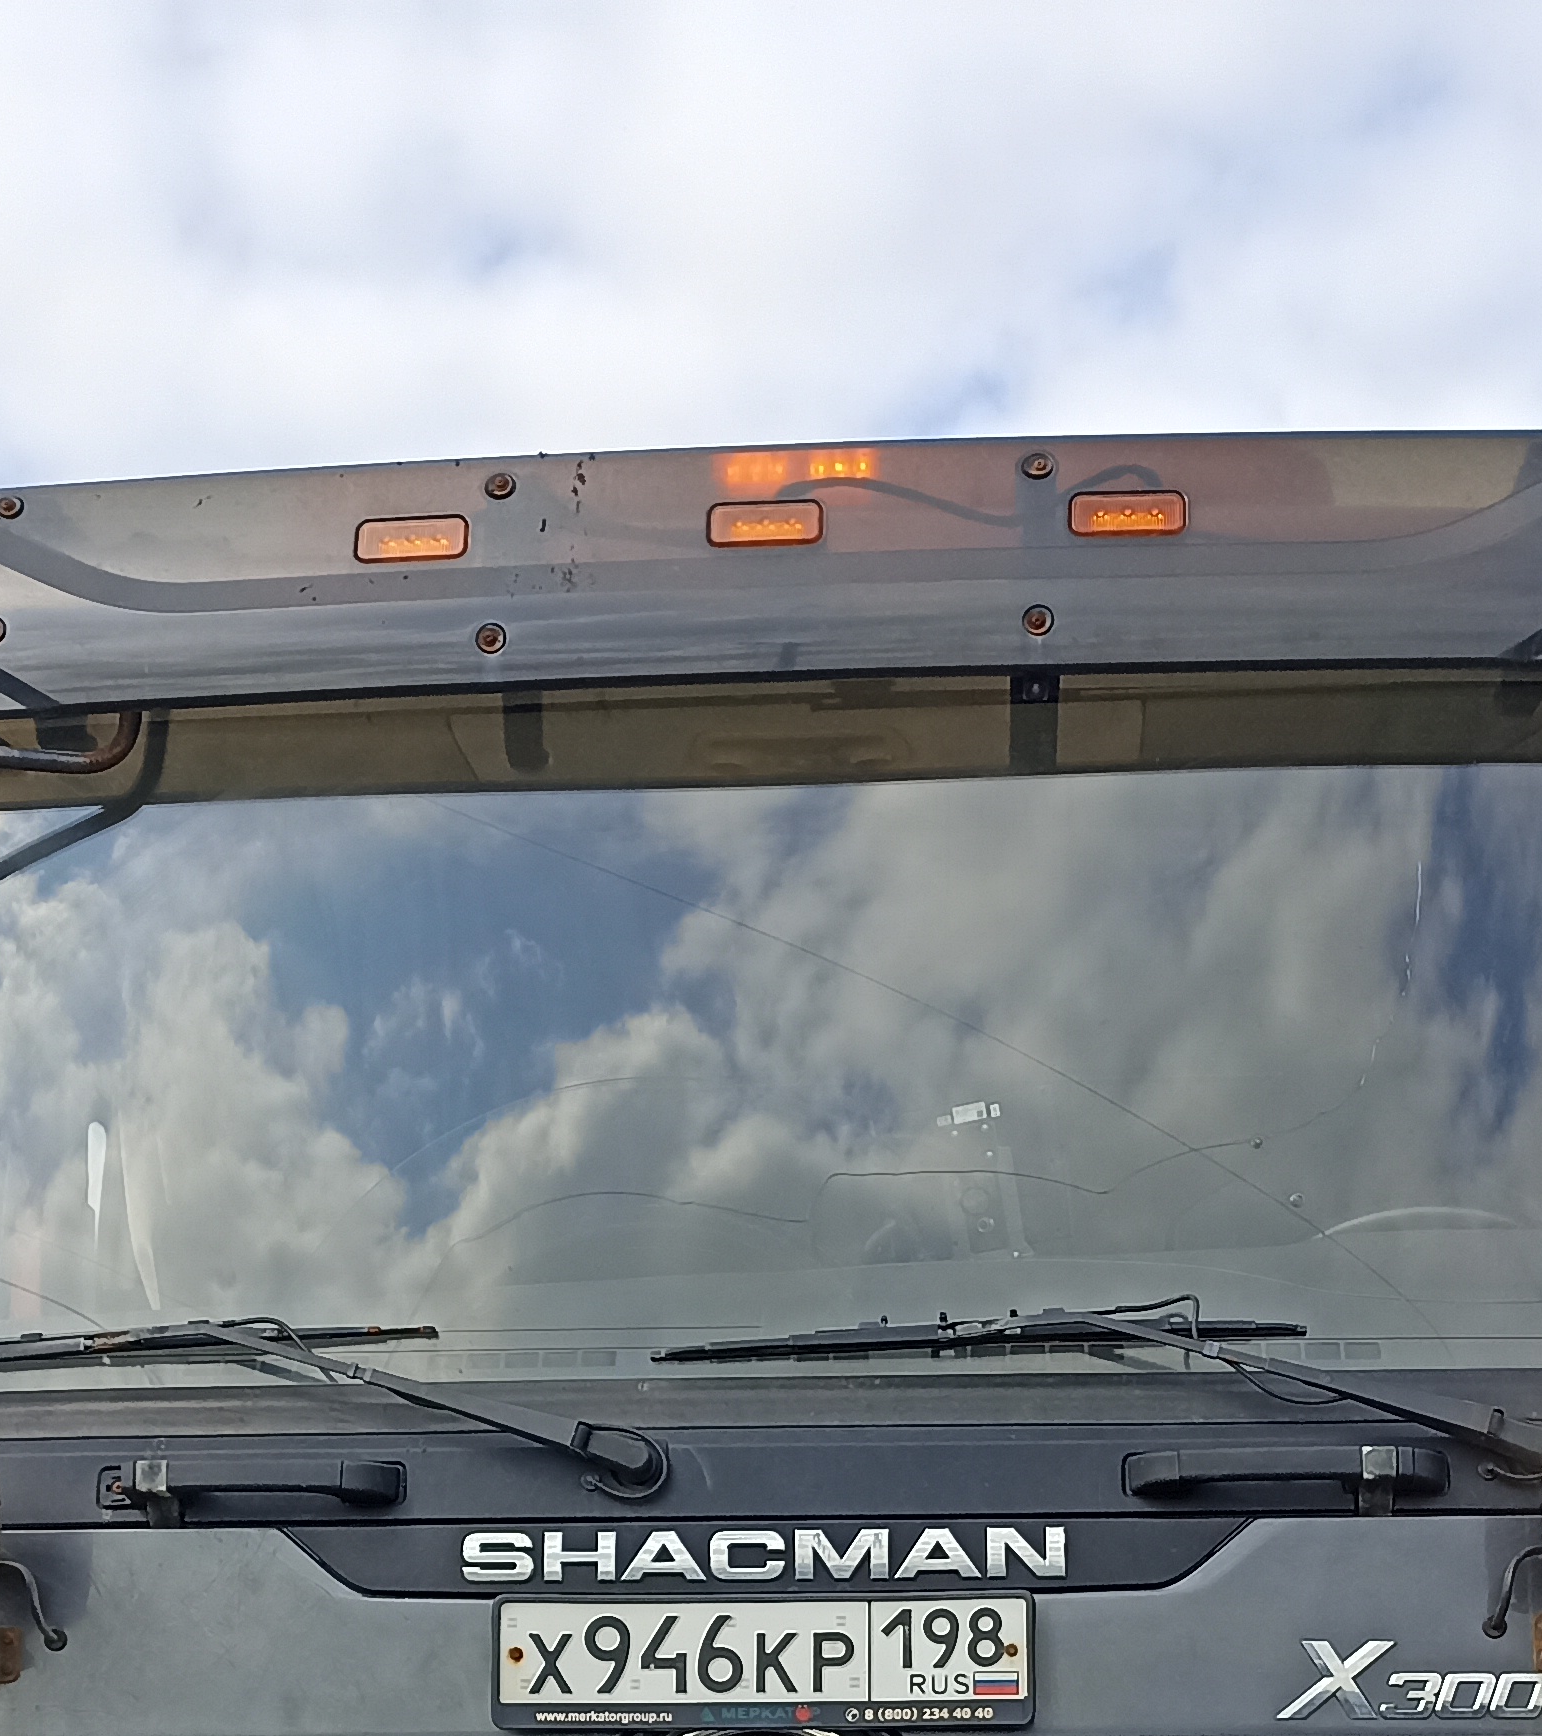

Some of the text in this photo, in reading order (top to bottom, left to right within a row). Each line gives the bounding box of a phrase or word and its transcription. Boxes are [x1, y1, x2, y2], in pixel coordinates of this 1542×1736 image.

[462, 1526, 1066, 1582] SHACMAN
[528, 1607, 1005, 1694] Х946КР 198
[910, 1673, 970, 1694] RUS
[535, 1710, 673, 1724] www.merkatorgroup.ru
[864, 1707, 994, 1722] 8 (800) 234 40 40
